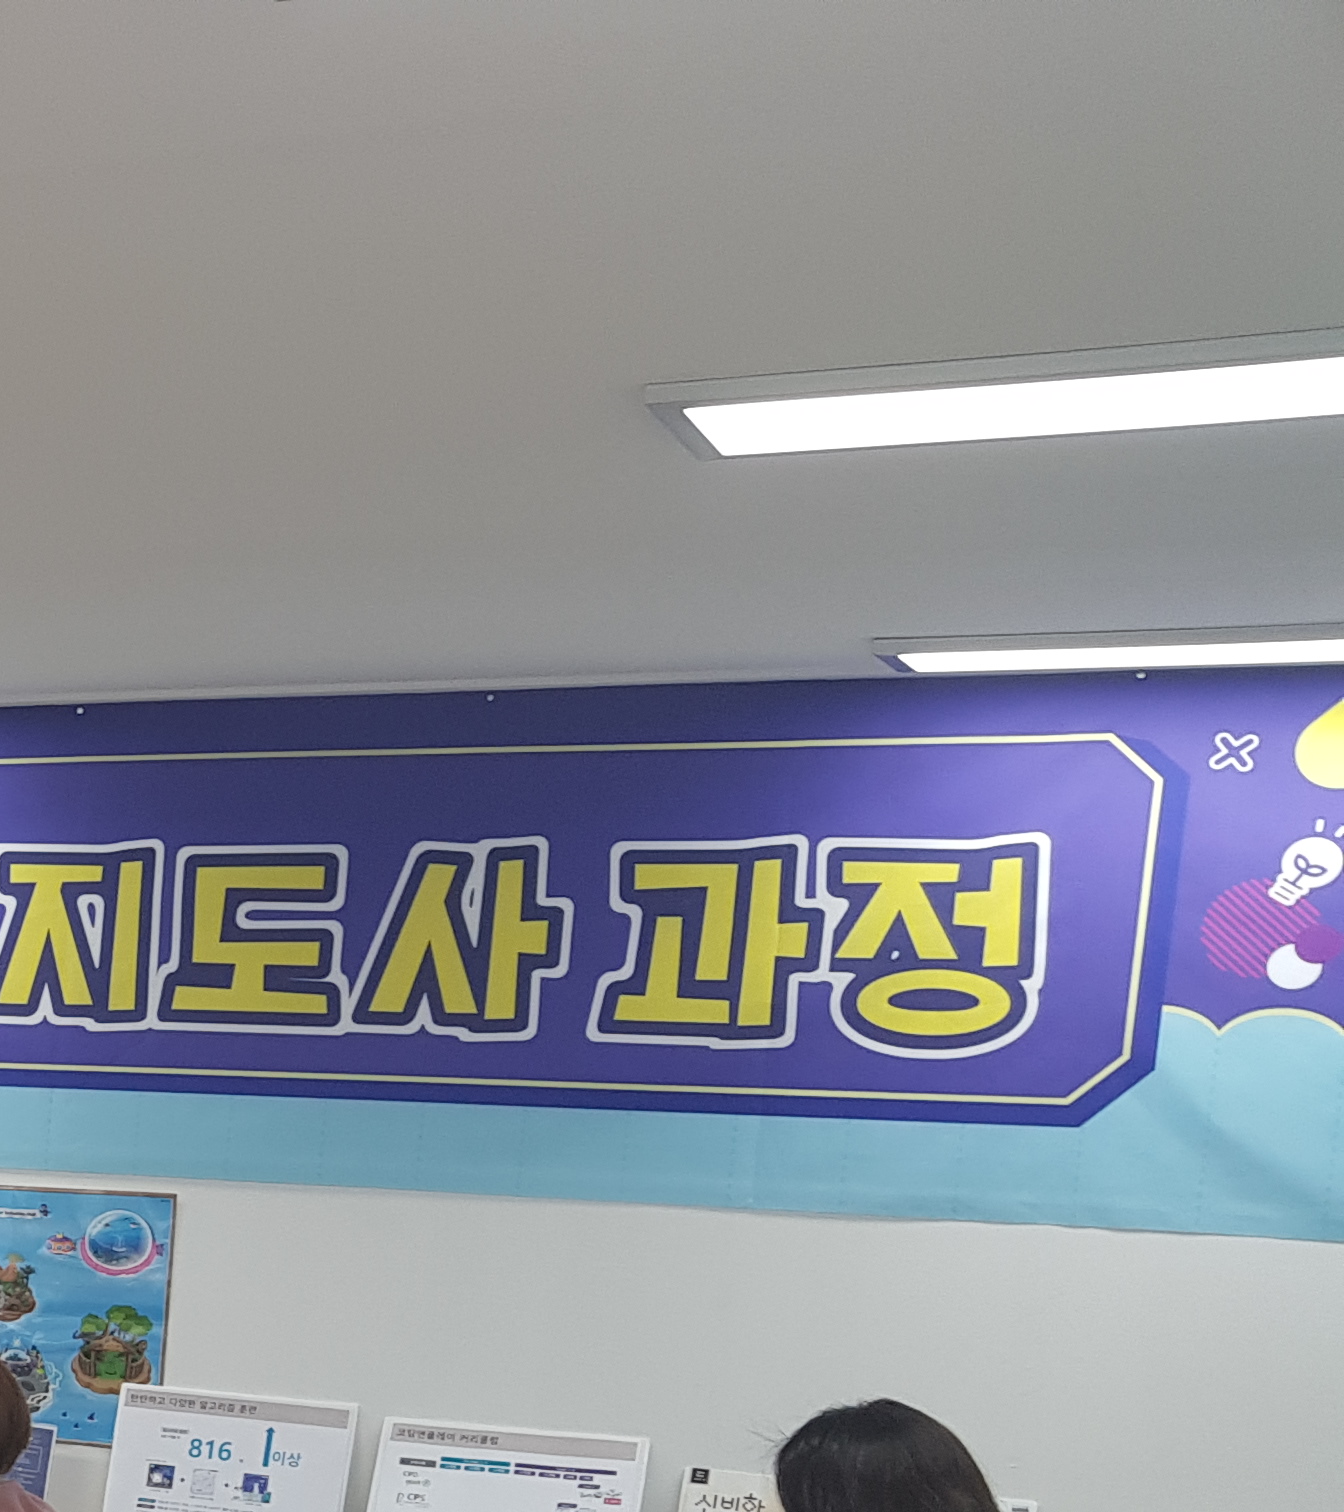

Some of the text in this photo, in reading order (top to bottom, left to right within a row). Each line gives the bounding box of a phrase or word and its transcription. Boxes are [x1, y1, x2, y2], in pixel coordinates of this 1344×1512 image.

[585, 833, 1052, 1059] 과정
[187, 1437, 233, 1462] 816
[272, 1450, 302, 1468] 이상
